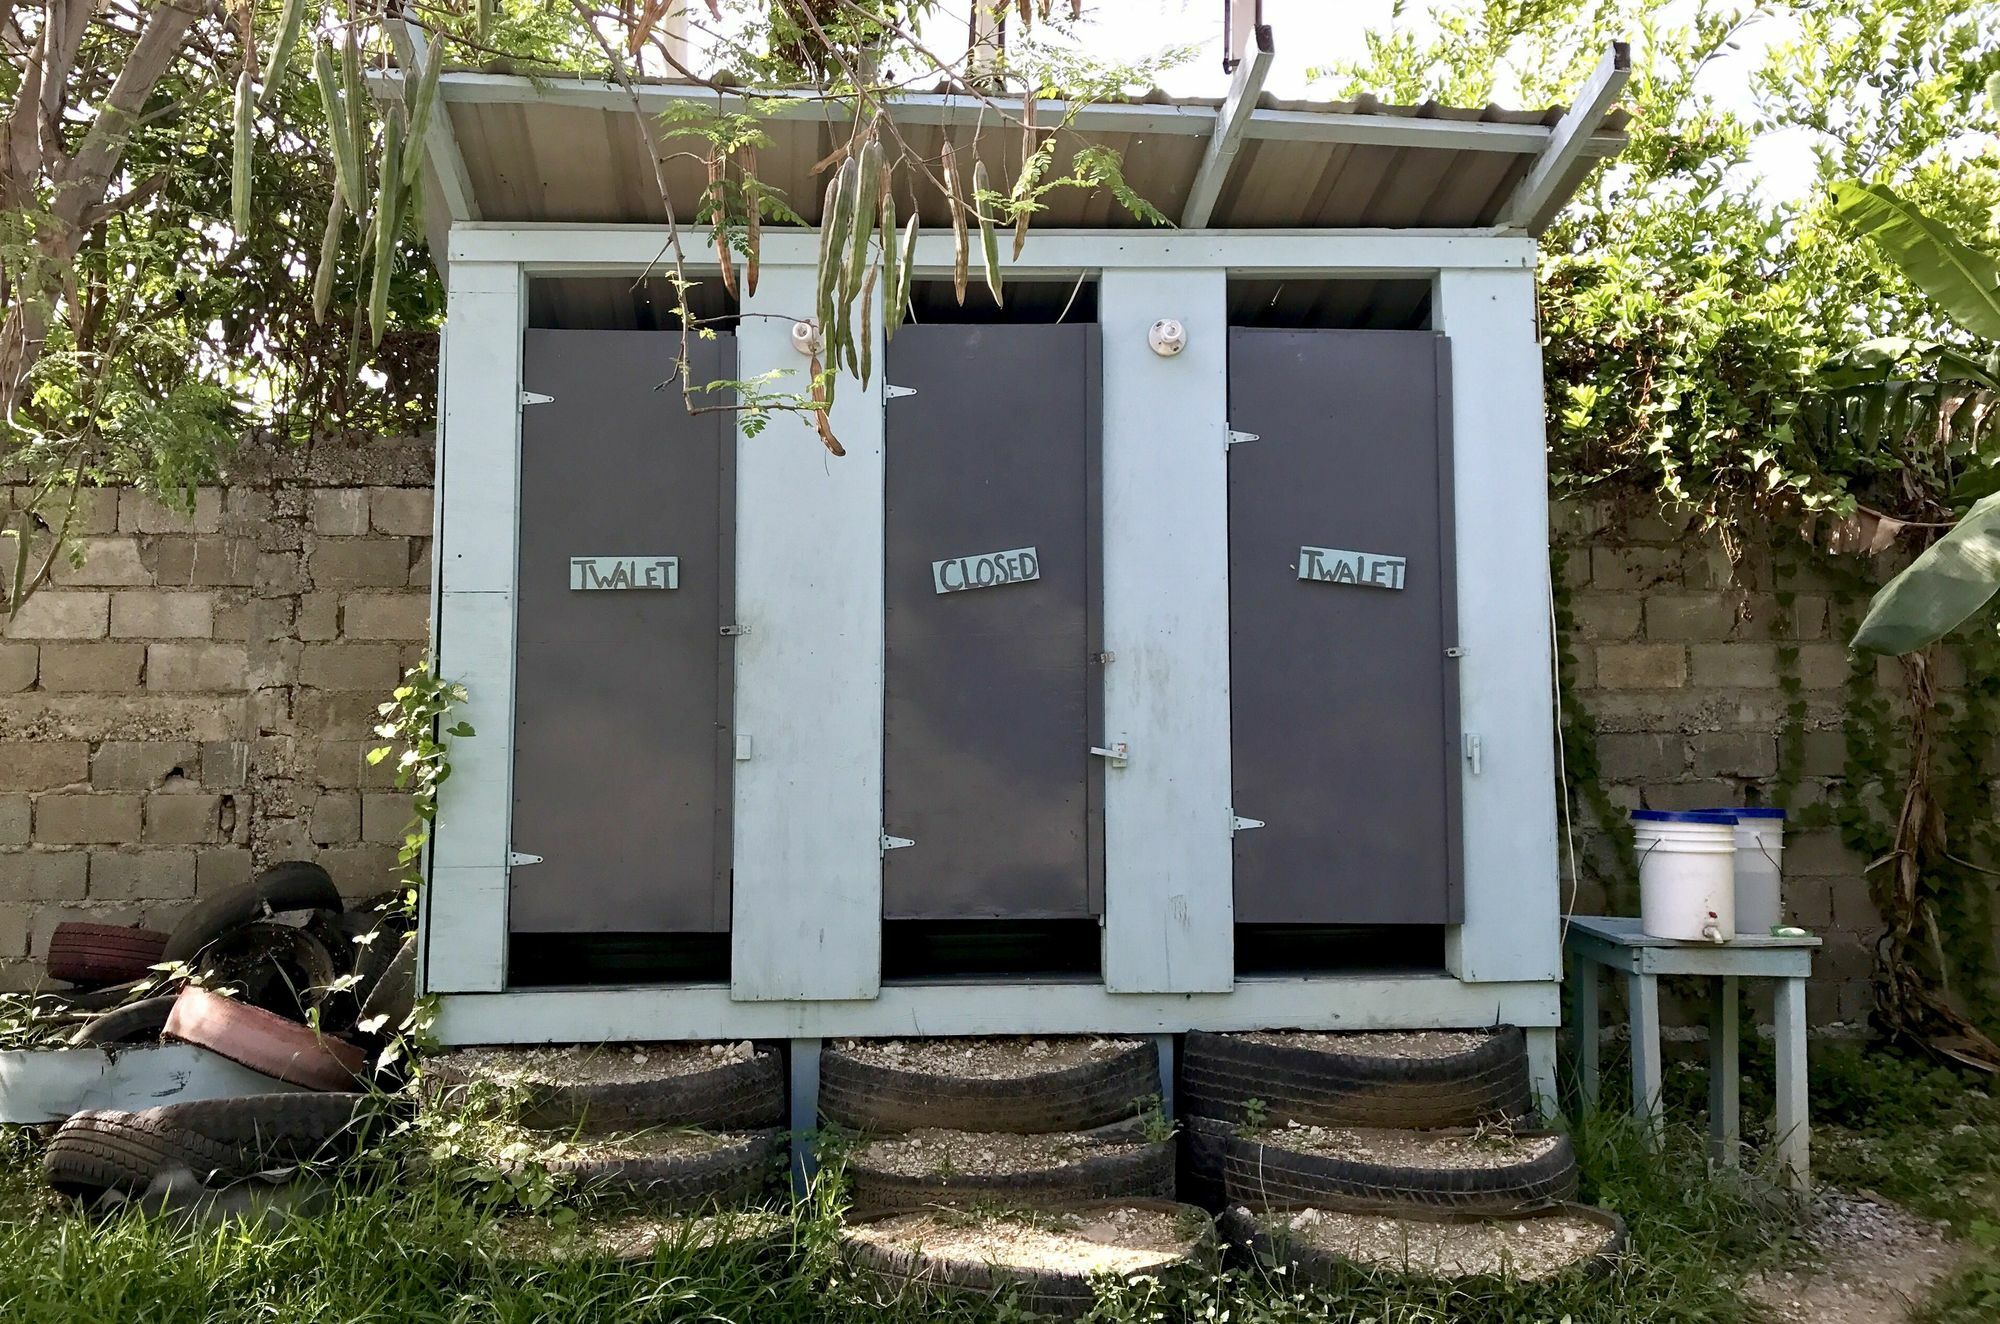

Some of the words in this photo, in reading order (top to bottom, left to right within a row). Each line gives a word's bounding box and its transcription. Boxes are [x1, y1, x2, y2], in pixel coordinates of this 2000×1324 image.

[572, 560, 675, 590] TWALET
[940, 553, 1037, 591] CLOSED
[1302, 550, 1404, 589] TWALET
